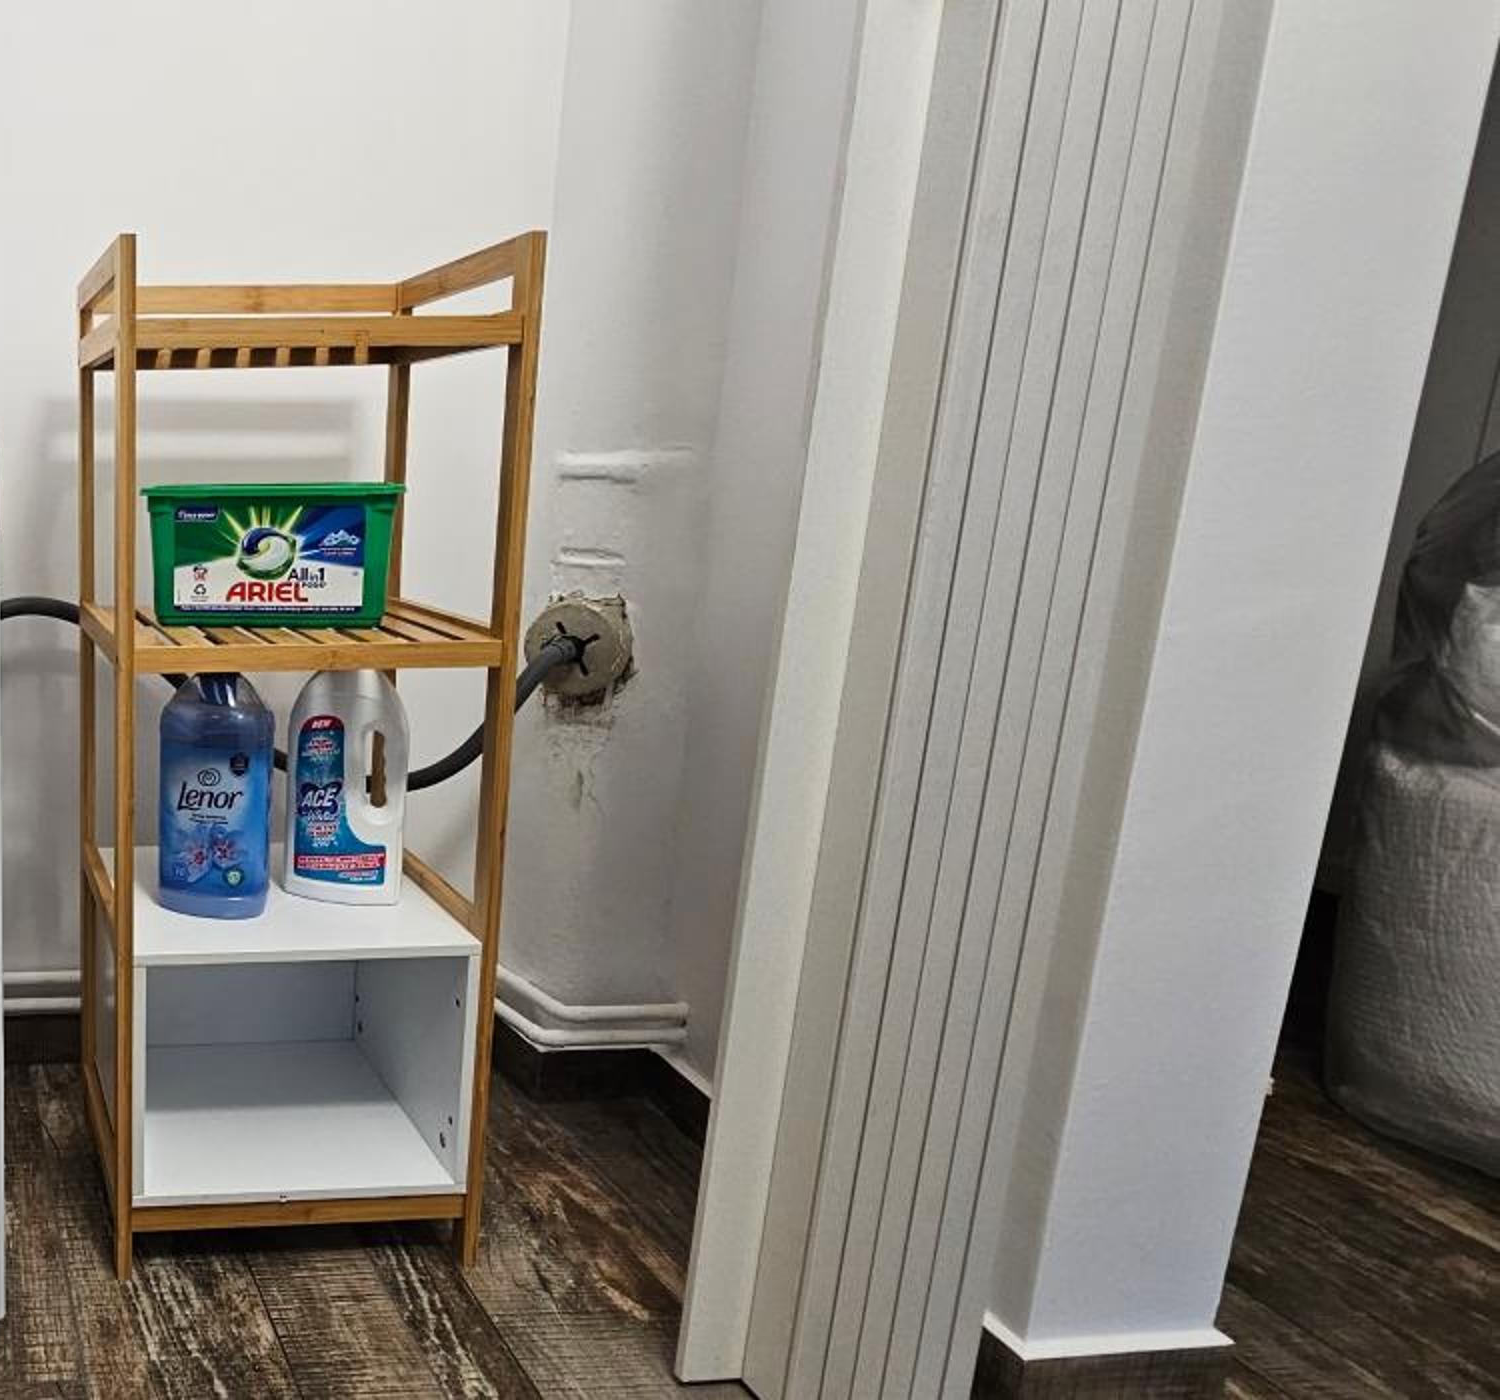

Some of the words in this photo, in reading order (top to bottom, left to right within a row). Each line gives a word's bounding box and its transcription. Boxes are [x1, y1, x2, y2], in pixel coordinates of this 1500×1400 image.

[226, 582, 308, 602] ARIEL
[177, 780, 244, 811] Lenor
[301, 787, 337, 807] ACE
